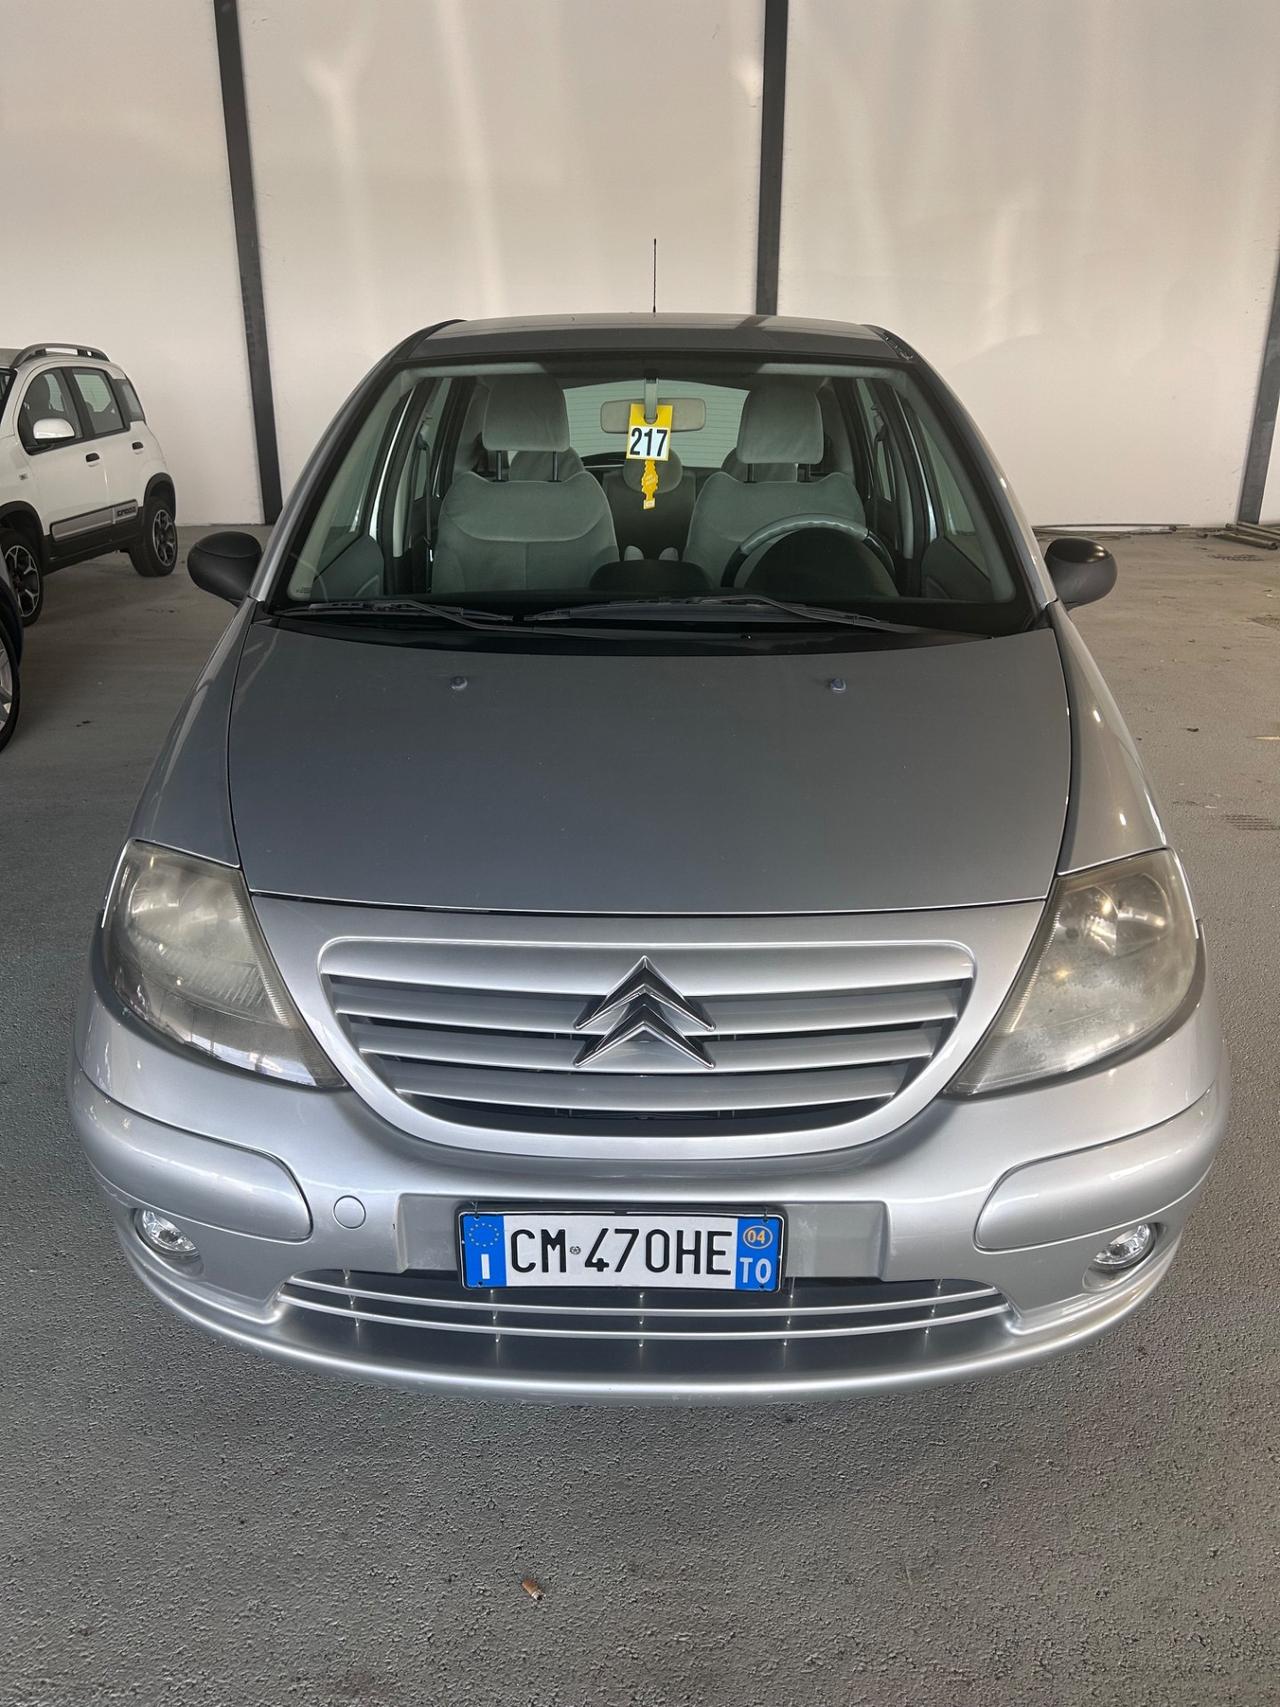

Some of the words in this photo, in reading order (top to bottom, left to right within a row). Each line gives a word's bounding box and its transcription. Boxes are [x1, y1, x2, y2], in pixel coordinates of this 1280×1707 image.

[630, 427, 668, 457] 217
[747, 1230, 766, 1244] 04
[510, 1228, 567, 1274] CM
[584, 1228, 732, 1275] 470HE
[481, 1253, 490, 1279] I
[740, 1257, 772, 1284] TO
